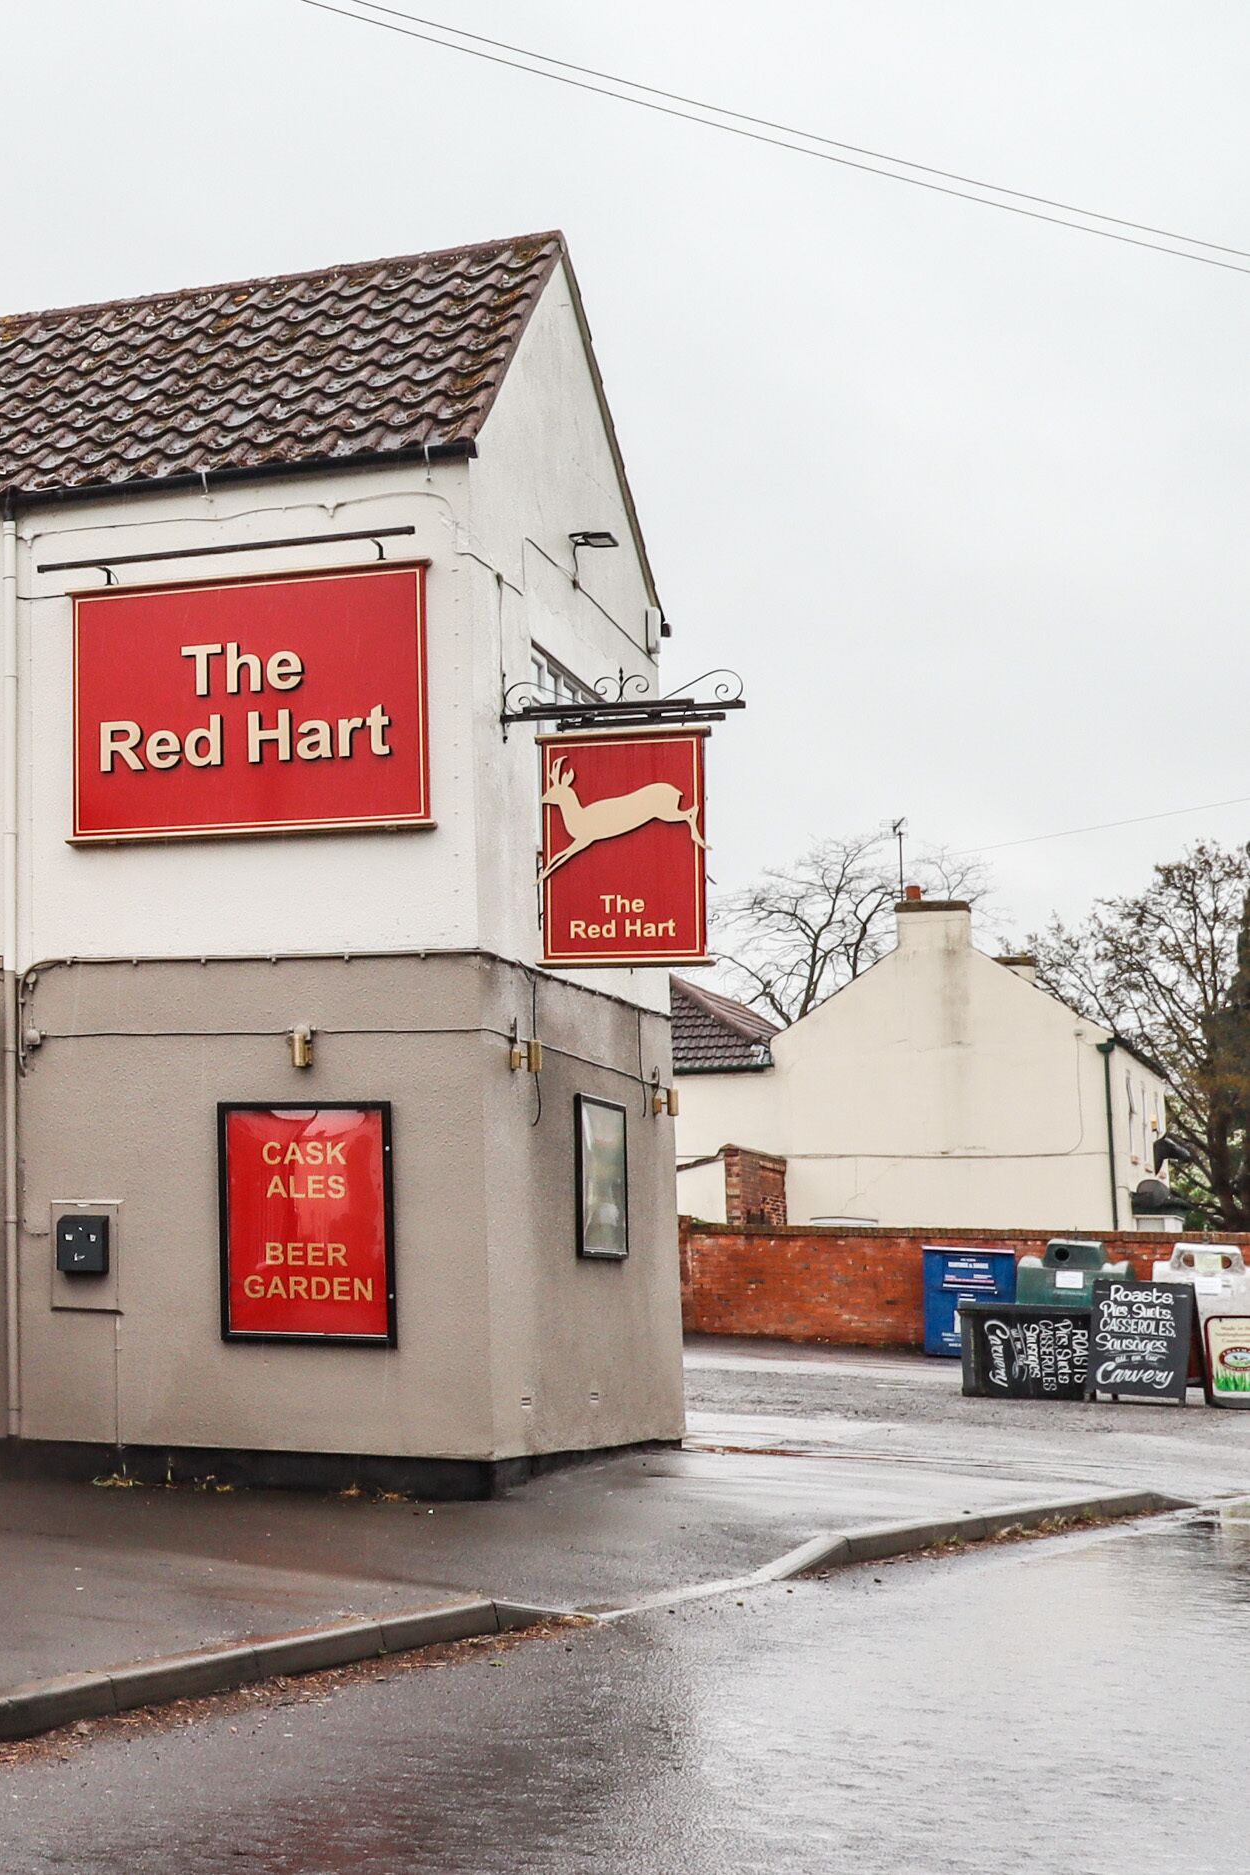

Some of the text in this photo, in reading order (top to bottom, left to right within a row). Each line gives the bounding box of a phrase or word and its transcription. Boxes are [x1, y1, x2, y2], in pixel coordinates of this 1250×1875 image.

[180, 641, 304, 696] The
[99, 703, 391, 773] Red Hart
[600, 894, 645, 914] The
[569, 918, 676, 939] Red Hart
[261, 1141, 347, 1166] CASK
[266, 1174, 346, 1199] ALES
[264, 1241, 348, 1267] BEER
[243, 1274, 373, 1302] GARDEN
[984, 1320, 1009, 1388] Carvery
[1038, 1319, 1058, 1391] CASSEROLES
[1095, 1332, 1170, 1356] Sausages
[1095, 1361, 1175, 1390] Carvery
